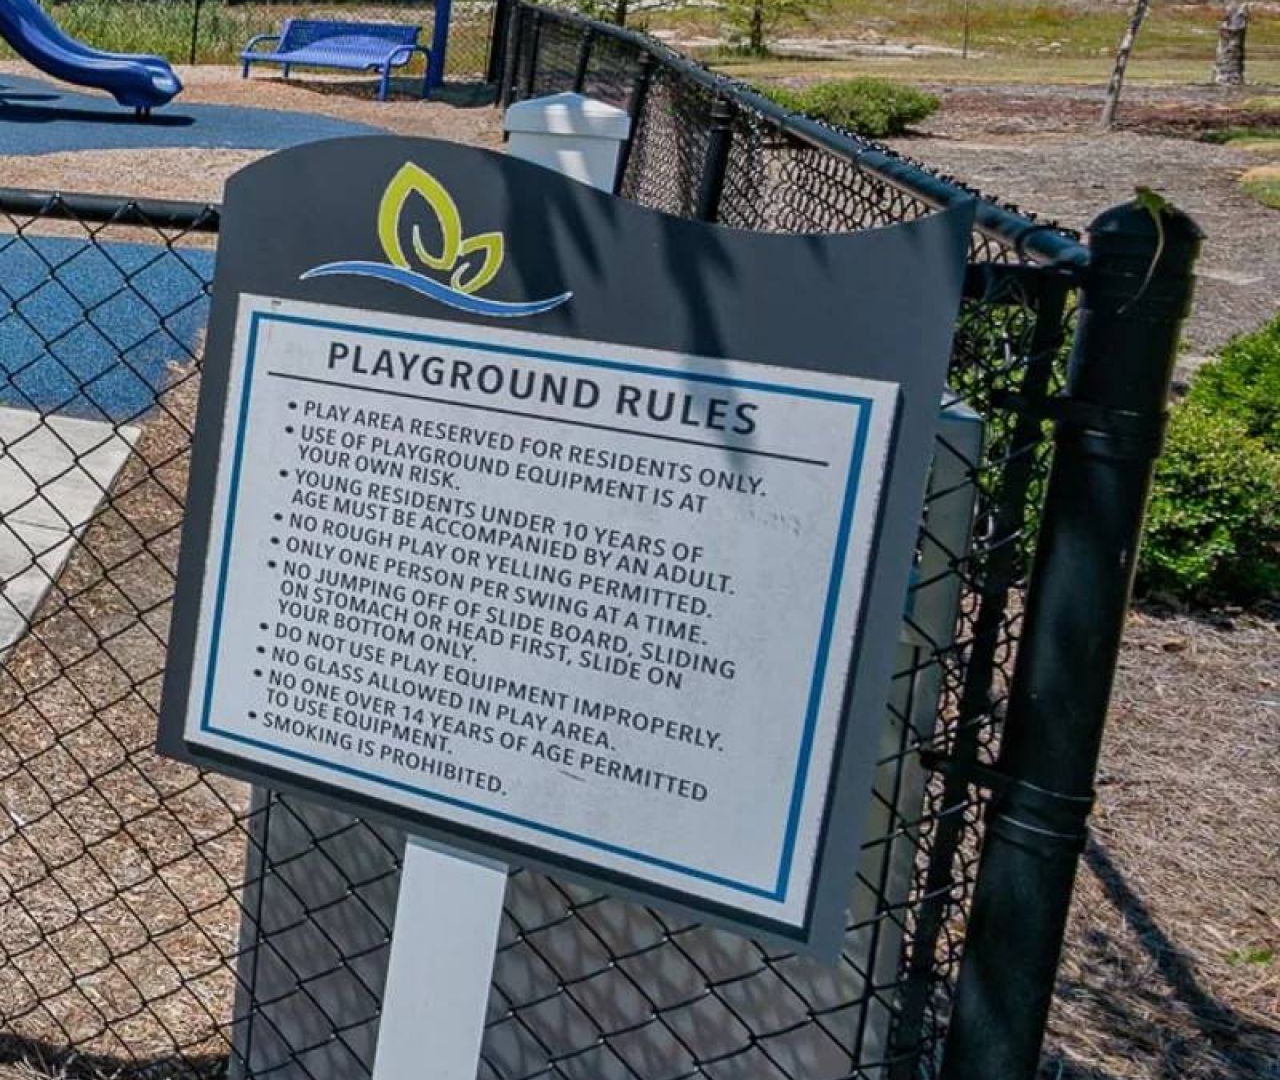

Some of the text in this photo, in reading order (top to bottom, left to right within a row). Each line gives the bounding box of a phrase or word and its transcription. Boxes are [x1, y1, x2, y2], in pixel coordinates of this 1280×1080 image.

[328, 341, 758, 435] PLAYGROUND RULES
[298, 444, 459, 490] YOUR OWN RISK.
[301, 424, 707, 513] USE OF PLAYGROUND EQUIPMENT IS AT
[304, 400, 765, 496] PLAY AREA RESERVED FOR RESIDENTS ONLY.
[289, 512, 712, 618] NO ROUGH PLAY OR YELLING PERMITTED.
[291, 488, 734, 594] AGE MUST BE ACCOMPANIED BY AN ADULT.
[295, 468, 703, 563] YOUNG RESIDENTS UNDER 10 YEARS OF
[278, 598, 477, 662] YOUR BOTTOM ONLY.
[280, 580, 682, 689] ON STOMACH OR HEAD FIRST, SLIDE ON
[283, 560, 735, 679] NO JUMPING OFF OF SLIDE BOARD, SLIDING
[286, 536, 707, 645] ONLY ONE PERSON PER SWING AT A TIME.
[267, 688, 452, 754] TO USE EQUIPMENT.
[269, 669, 707, 801] NO ONE OVER 14 YEARS OF AGE PERMITTED
[272, 645, 615, 751] NO GLASS ALLOWED IN PLAY AREA.
[275, 622, 723, 751] DO NOT USE PLAY EQUIPMENT IMPROPERLY.
[263, 711, 506, 796] SMOKING IS PROHIBITED.
